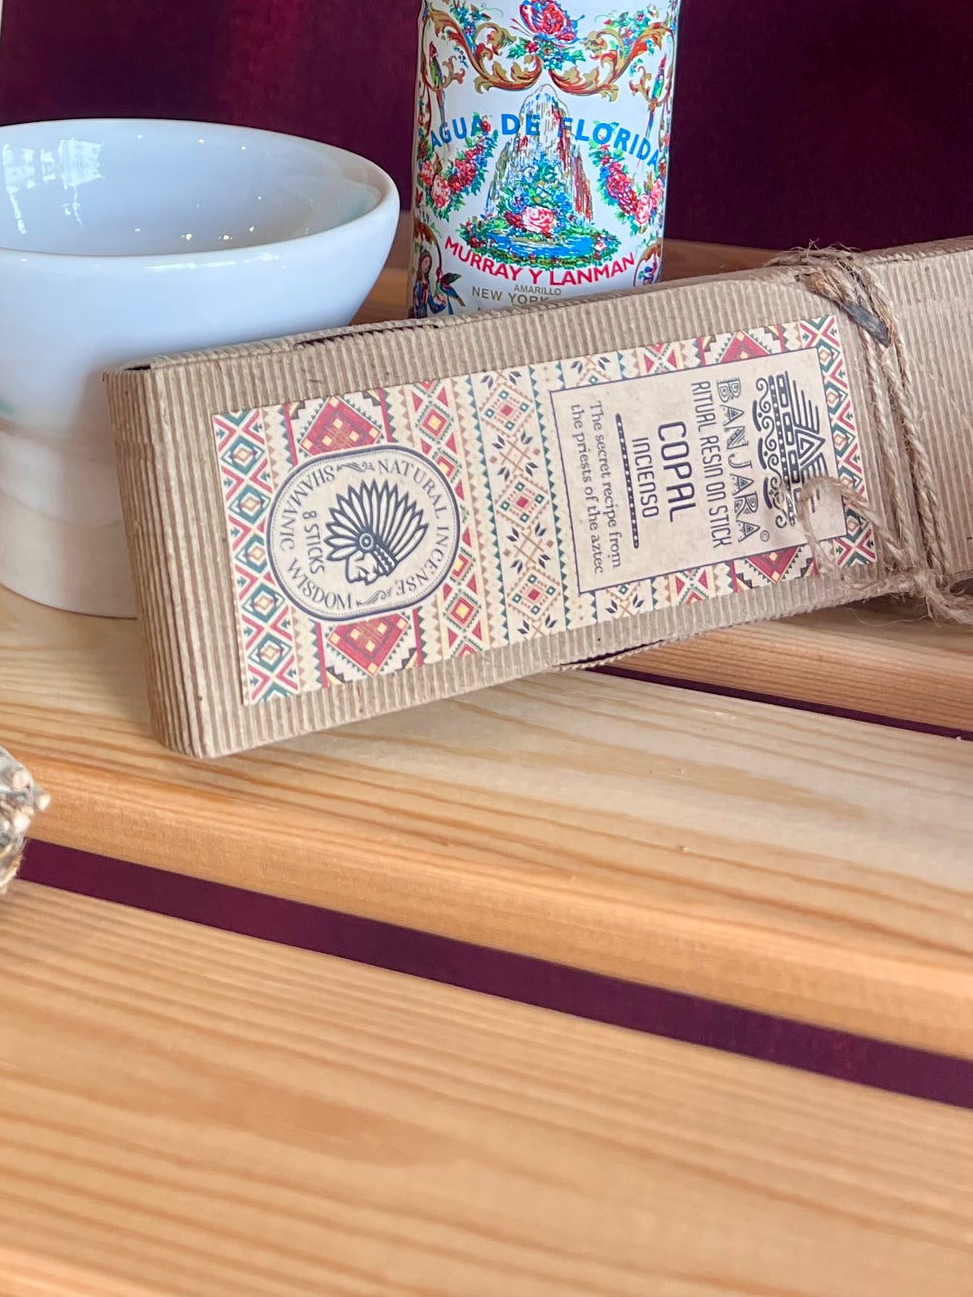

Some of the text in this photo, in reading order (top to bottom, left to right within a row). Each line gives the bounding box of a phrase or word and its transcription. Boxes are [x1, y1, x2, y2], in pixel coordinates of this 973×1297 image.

[430, 113, 661, 167] AGUA DE FLORIDA
[444, 236, 635, 286] MURRAY Y LANMAN
[472, 286, 503, 301] NEW
[513, 284, 562, 296] AMARILLO
[570, 404, 604, 574] the priests of the aztec
[590, 400, 623, 569] The secret recipe from
[632, 437, 659, 518] INCIENSO
[658, 421, 696, 522] COPAL
[691, 380, 732, 548] RITUAL RESIN ON STICK
[716, 377, 760, 542] BANJARA
[279, 465, 353, 610] SHAMANIC WISDOM
[302, 510, 325, 575] 8 STICKS
[378, 458, 450, 595] NATURAL INCENSE
